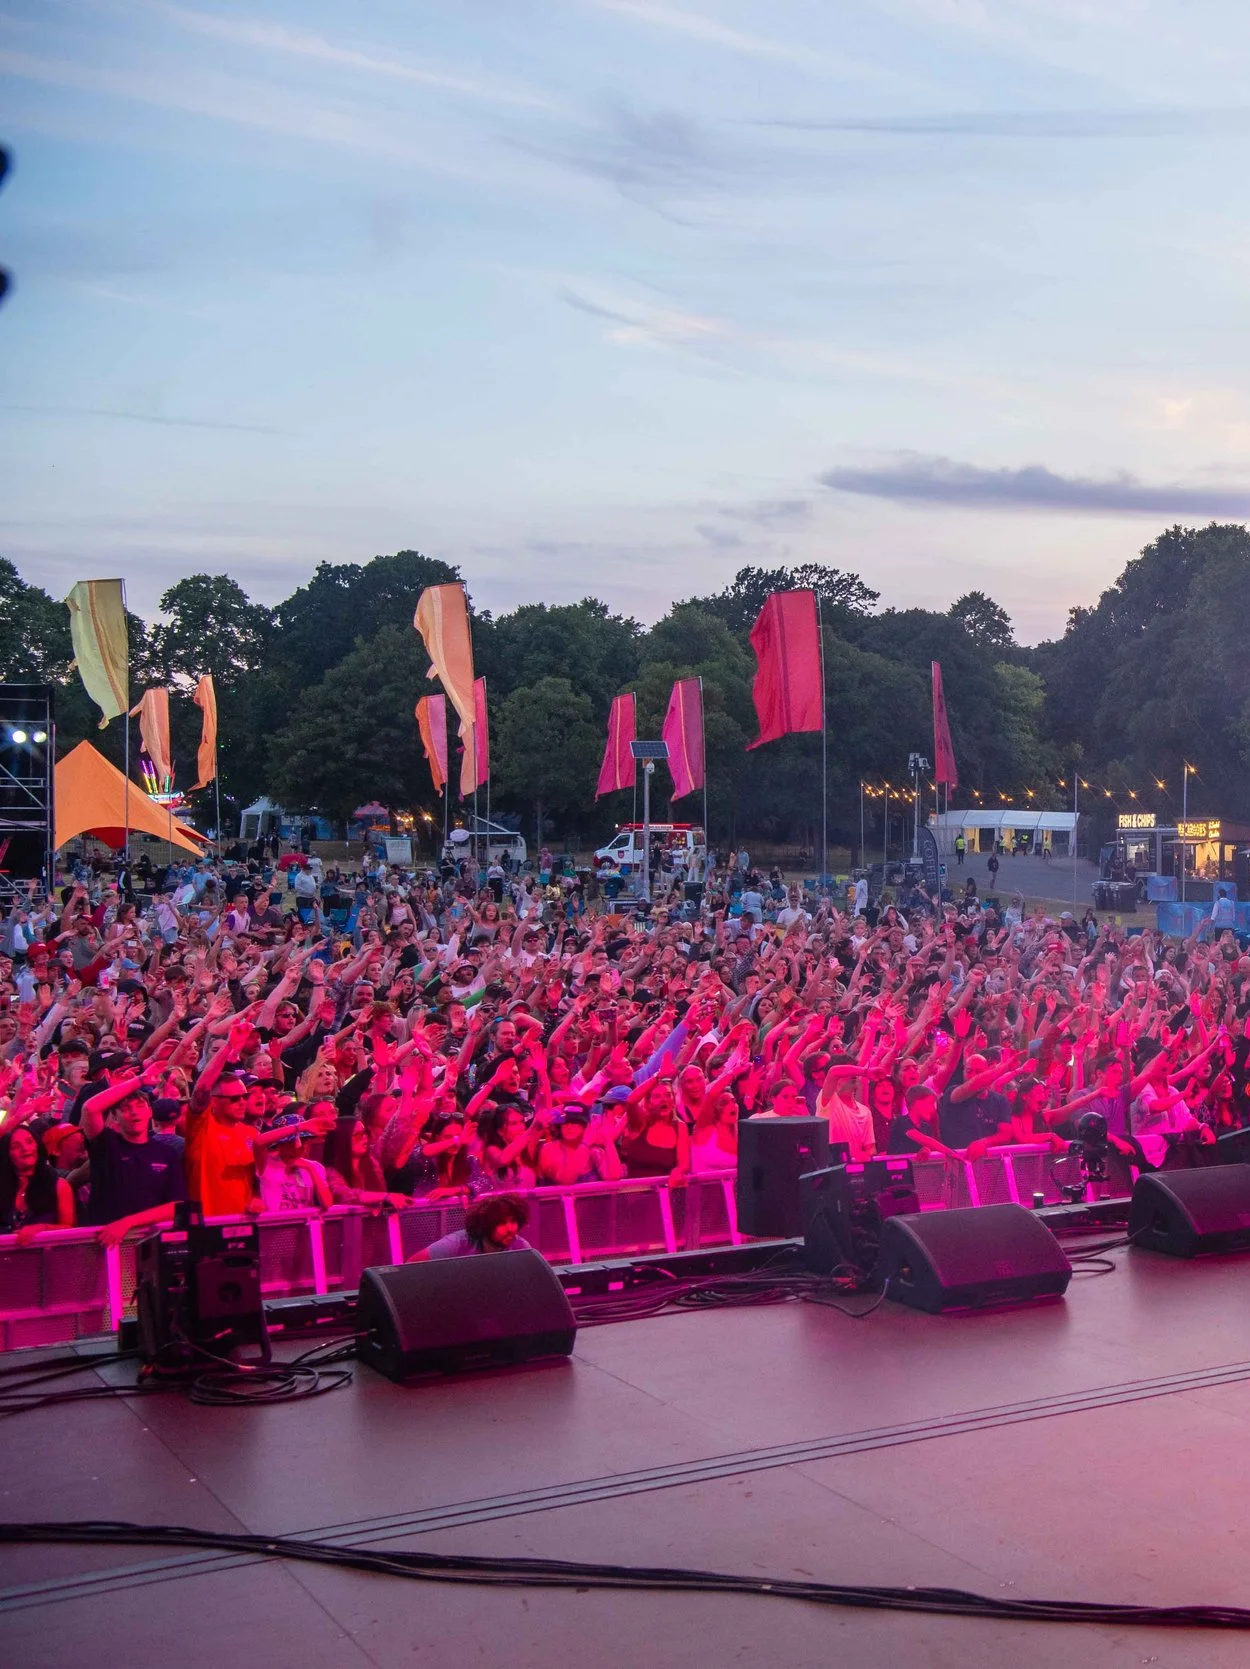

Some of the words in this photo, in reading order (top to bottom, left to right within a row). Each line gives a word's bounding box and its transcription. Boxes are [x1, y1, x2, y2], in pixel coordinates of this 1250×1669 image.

[1118, 814, 1132, 828] FISH
[1132, 813, 1137, 828] &
[1137, 813, 1156, 828] CHIPS
